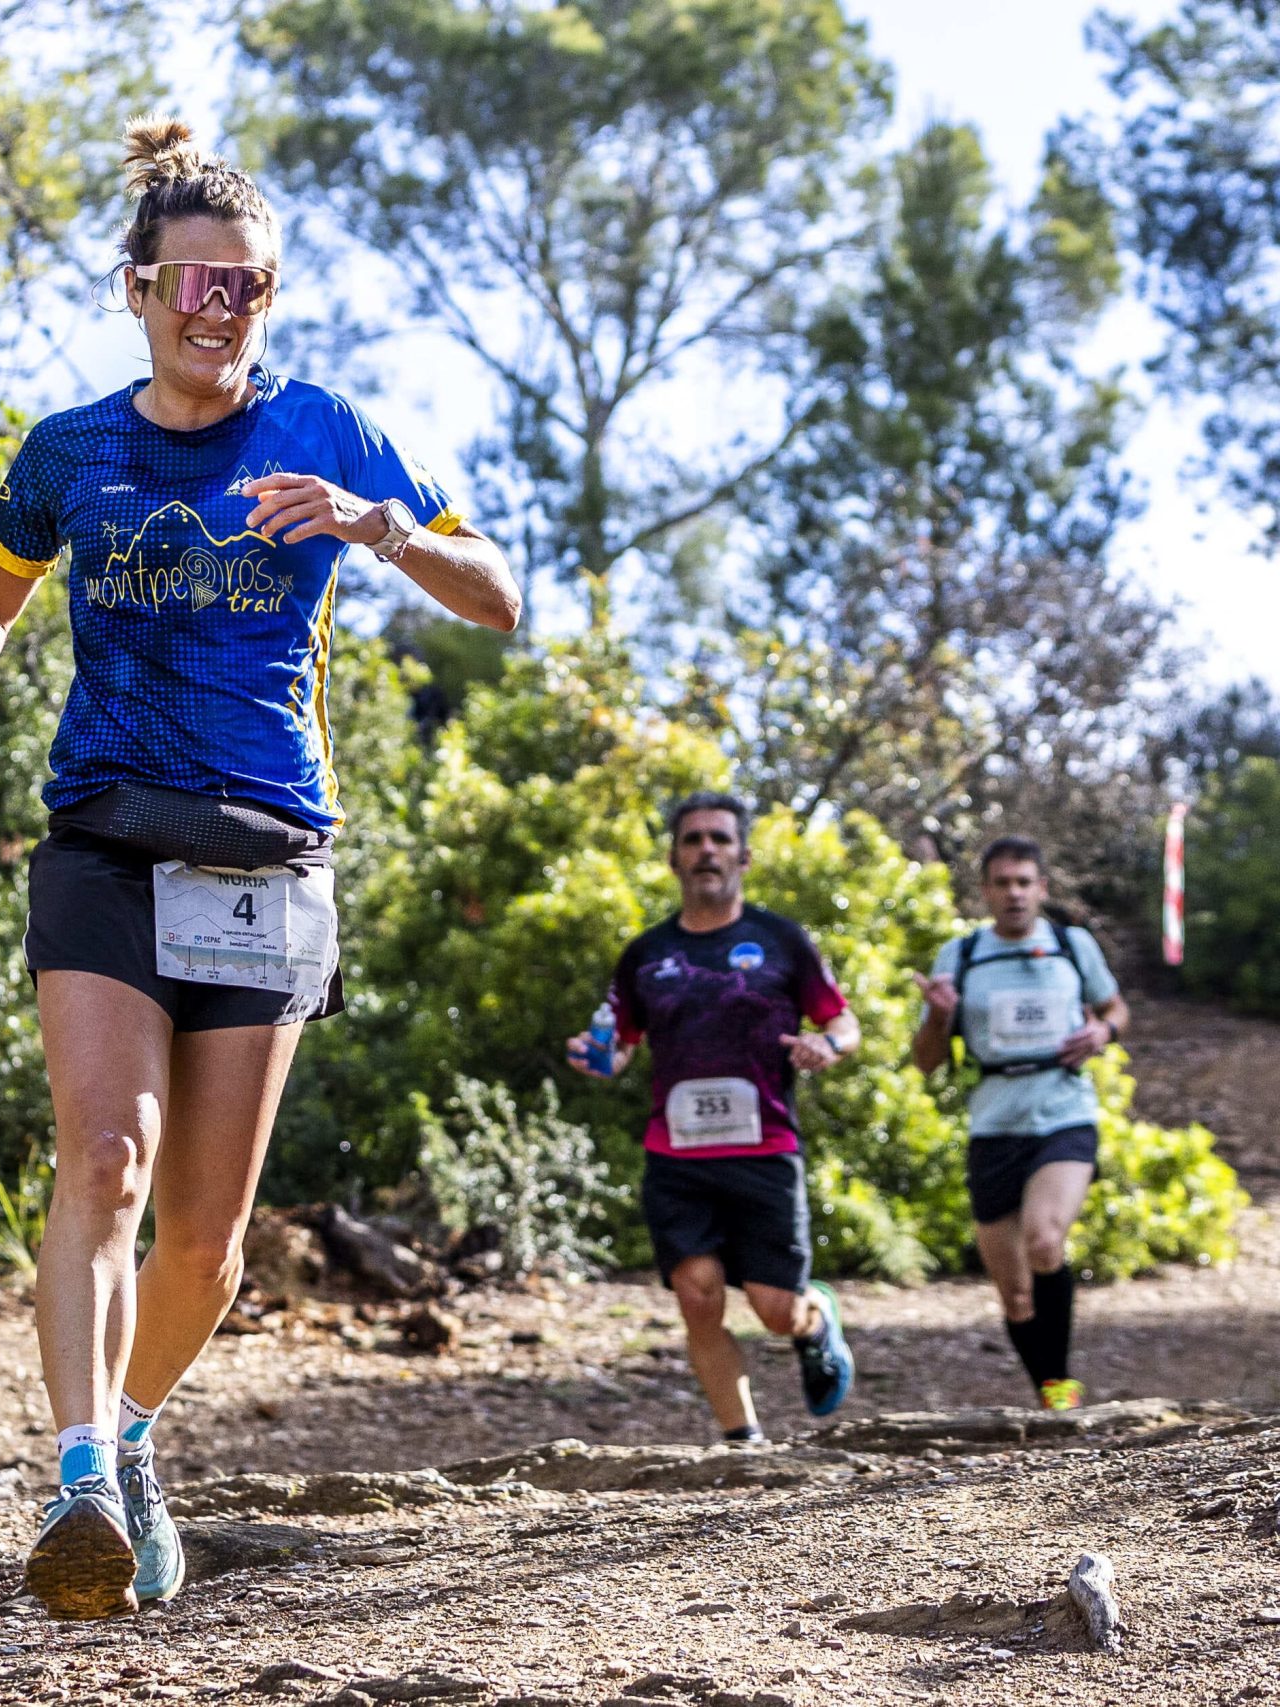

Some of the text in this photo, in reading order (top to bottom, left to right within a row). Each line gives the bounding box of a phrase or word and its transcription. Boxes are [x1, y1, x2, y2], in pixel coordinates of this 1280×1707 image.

[227, 588, 285, 612] trail
[233, 893, 257, 926] 4
[694, 1096, 731, 1116] 253
